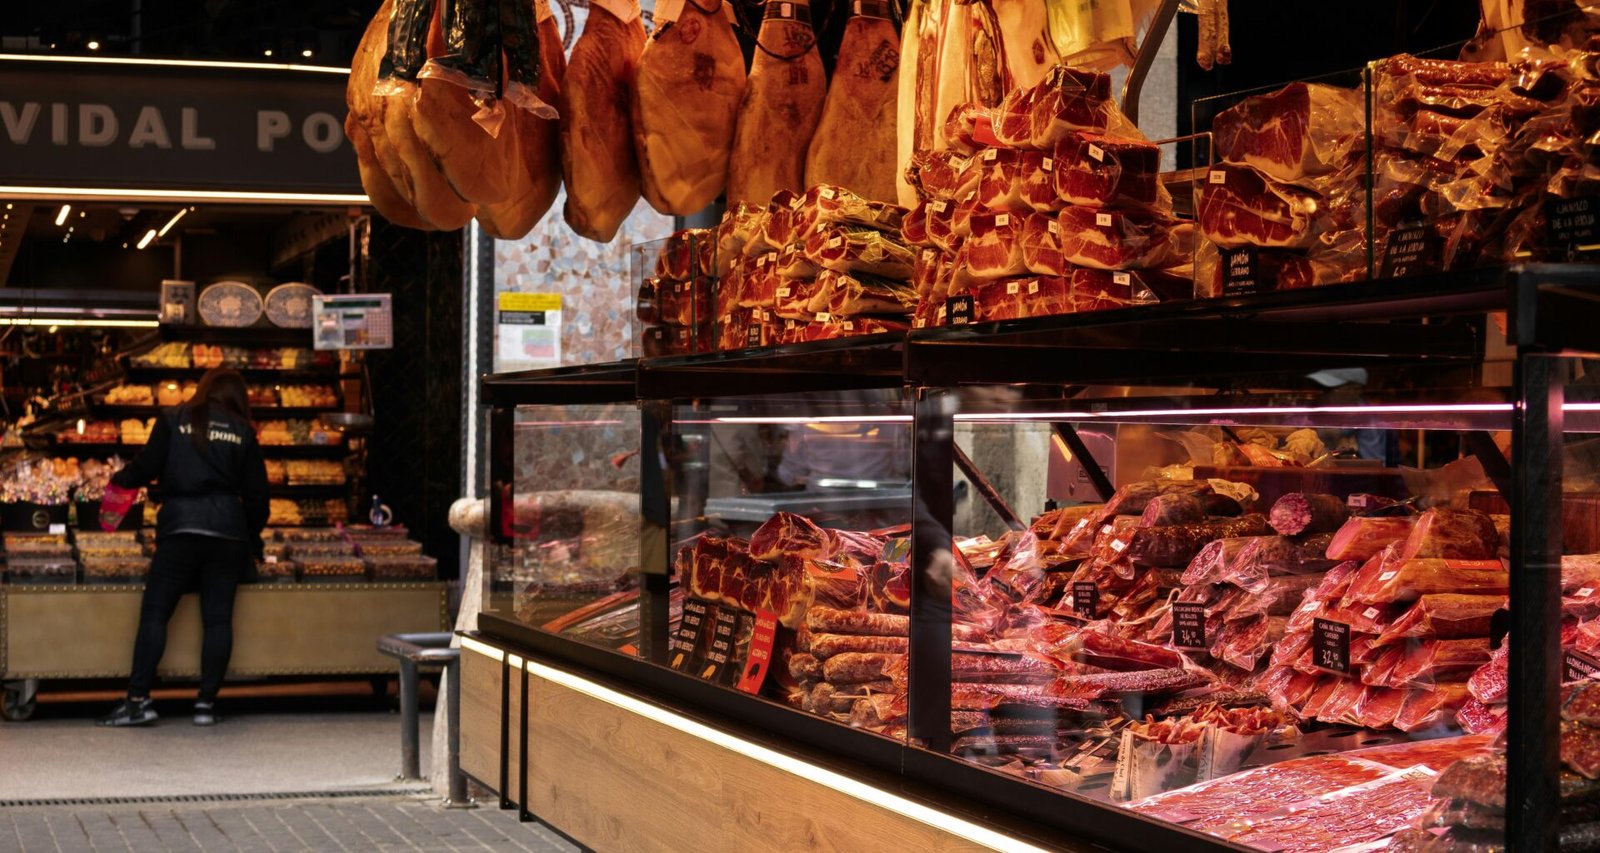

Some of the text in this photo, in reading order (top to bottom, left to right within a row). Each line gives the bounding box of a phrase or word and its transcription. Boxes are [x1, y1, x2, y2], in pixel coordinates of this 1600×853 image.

[0, 101, 217, 150] VIDAL
[1230, 249, 1249, 268] JAMÓN
[952, 298, 968, 314] JAMÓN
